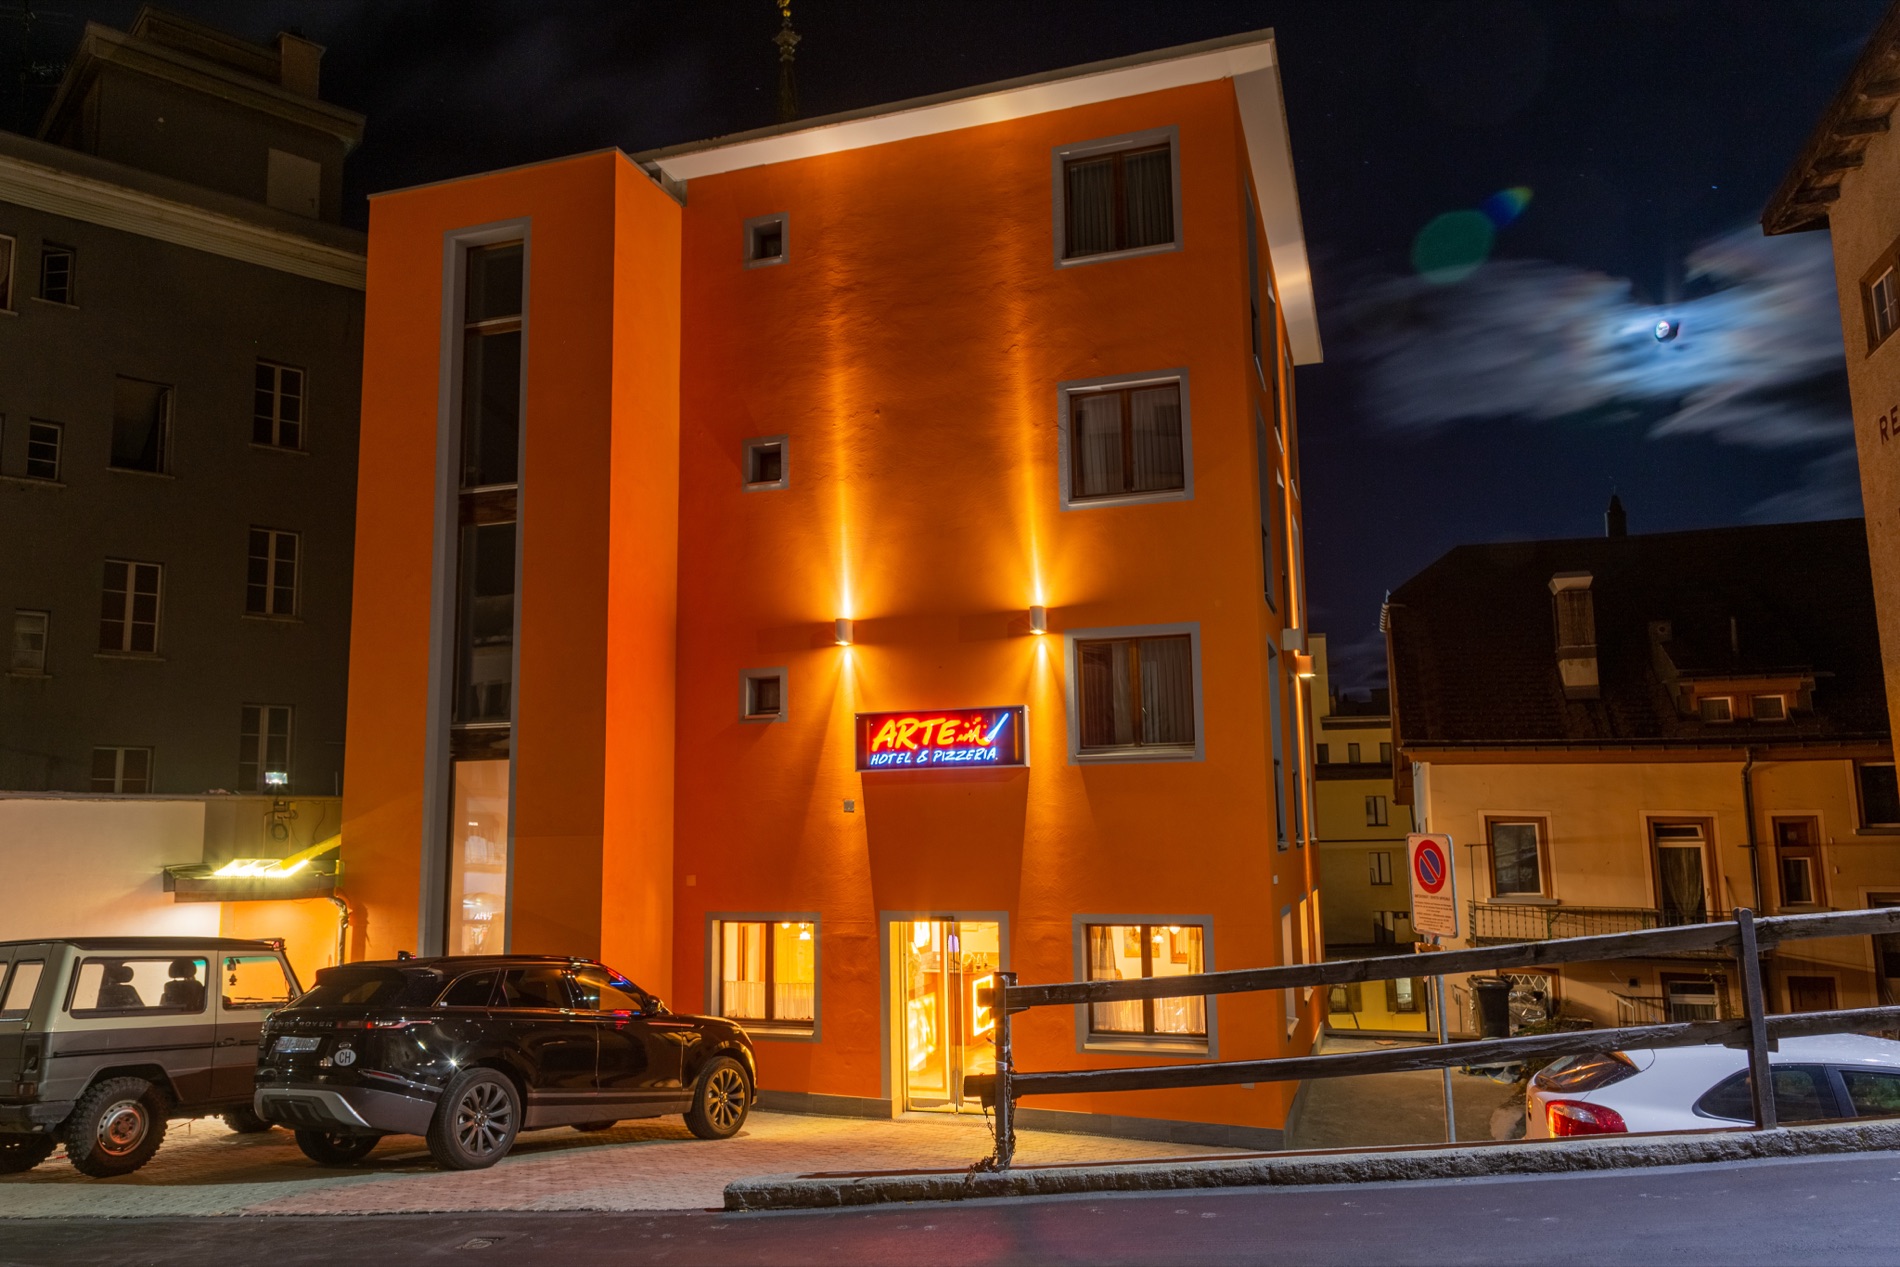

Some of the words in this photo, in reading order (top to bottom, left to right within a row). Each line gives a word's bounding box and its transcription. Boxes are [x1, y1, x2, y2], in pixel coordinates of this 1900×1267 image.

[871, 717, 961, 752] ARTE
[870, 752, 911, 766] HOTEL
[916, 750, 929, 763] &
[932, 747, 997, 763] PIZZERIA
[339, 1051, 351, 1064] CH
